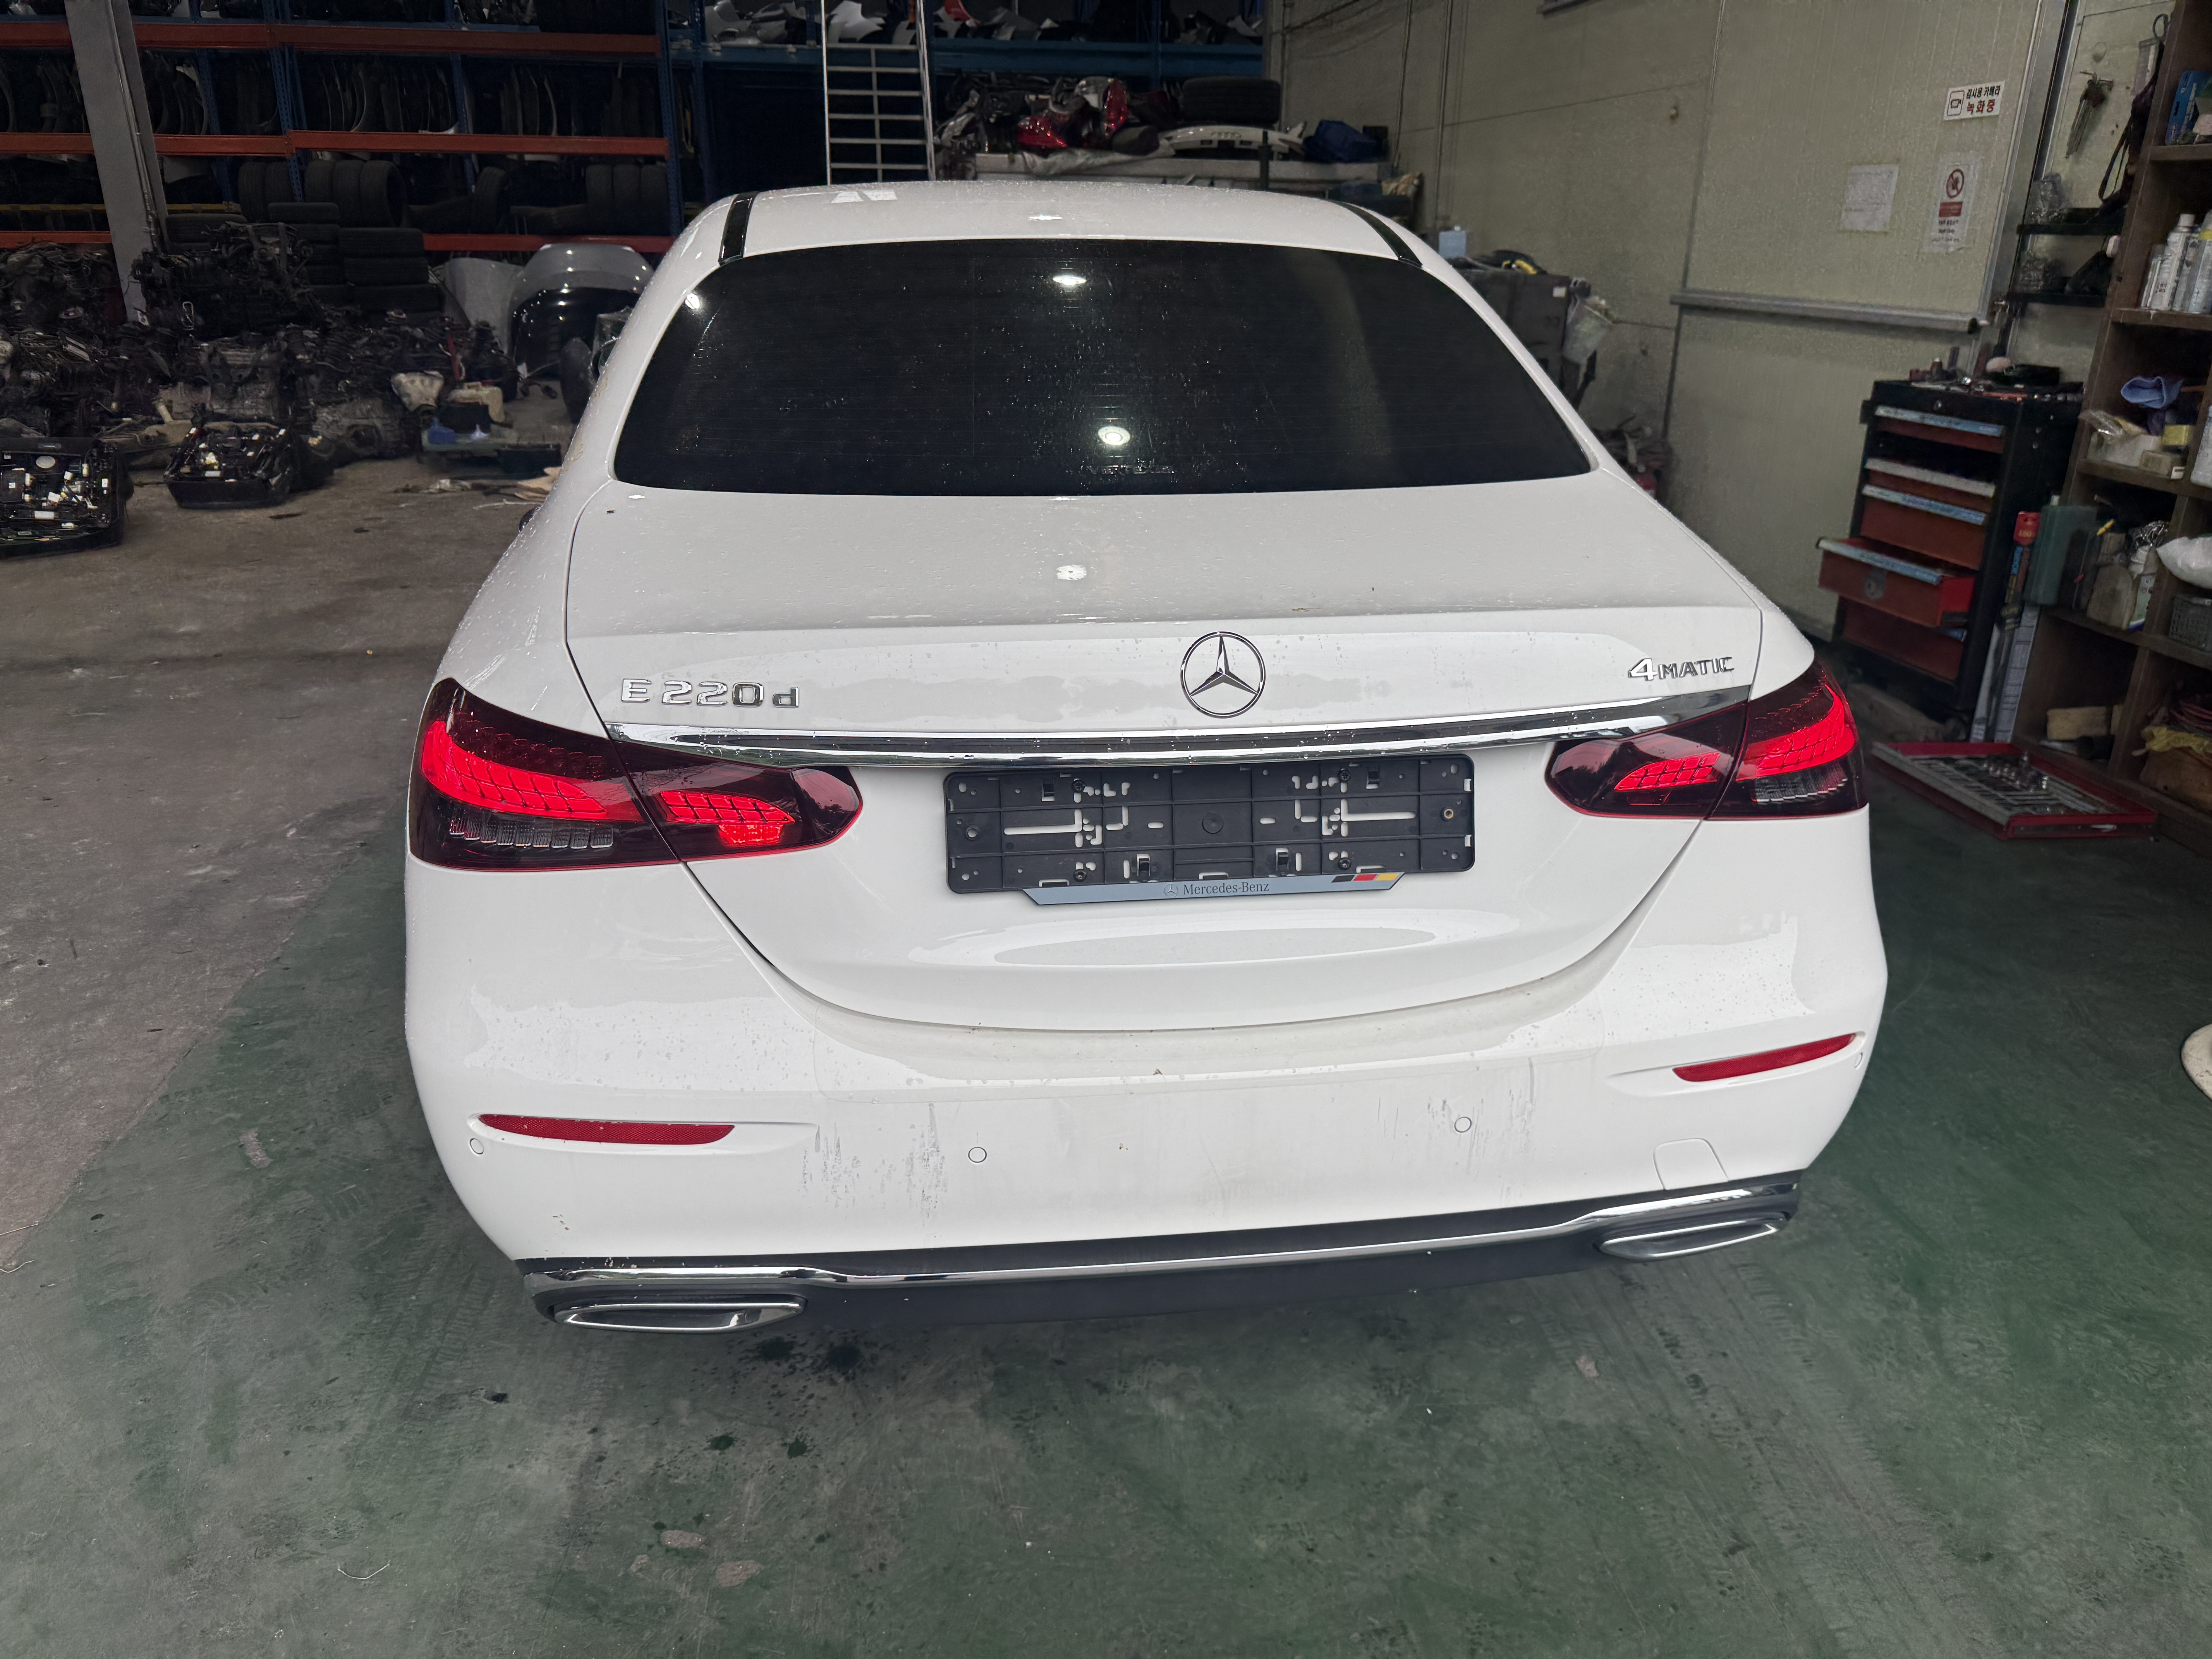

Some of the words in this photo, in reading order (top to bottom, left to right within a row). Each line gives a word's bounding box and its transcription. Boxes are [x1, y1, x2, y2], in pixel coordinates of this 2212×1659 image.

[1966, 87, 1982, 99] 감시용
[1984, 85, 2001, 97] 카메라
[1966, 99, 1996, 115] 녹화중
[1628, 657, 1735, 682] 4MATIC
[621, 678, 652, 703] E
[1183, 882, 1269, 895] Mercedes-Benz
